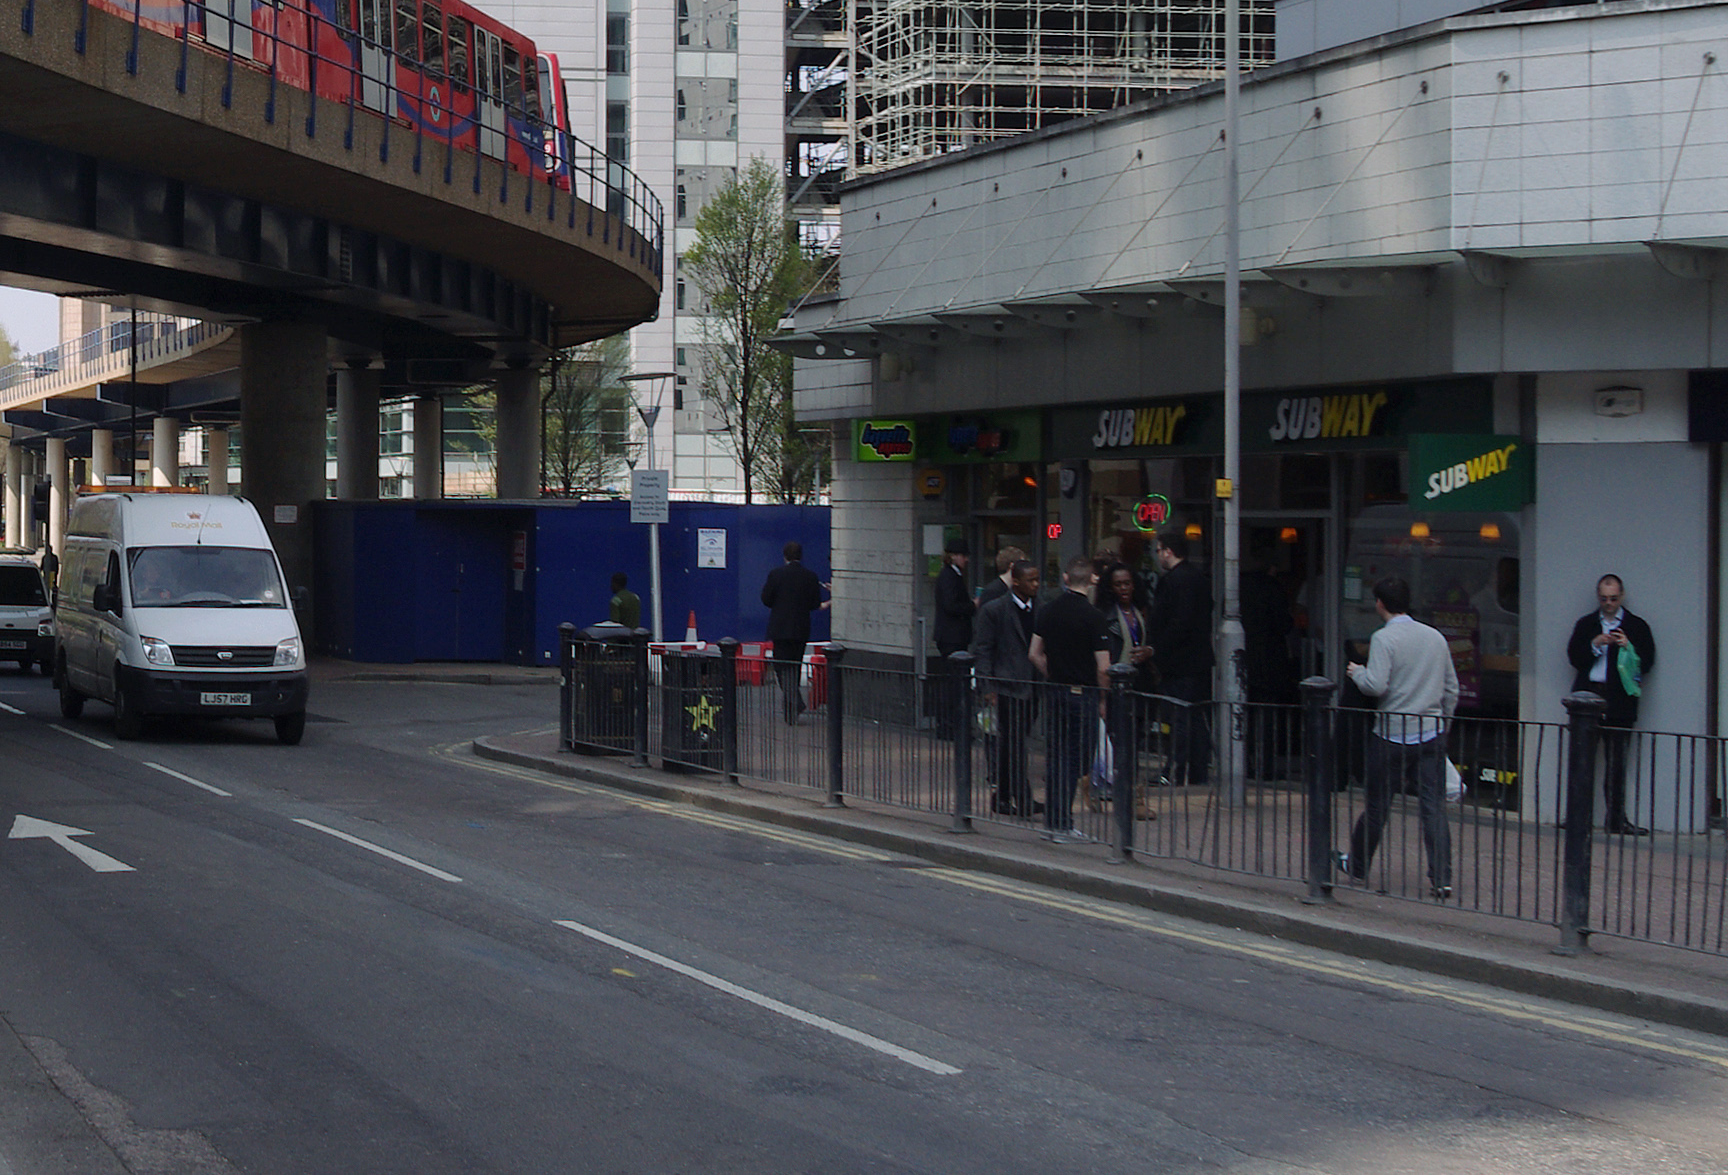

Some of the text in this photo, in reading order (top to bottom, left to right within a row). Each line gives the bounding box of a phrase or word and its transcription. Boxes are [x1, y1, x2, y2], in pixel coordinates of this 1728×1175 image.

[1092, 405, 1186, 448] SUBWAY
[1269, 391, 1388, 441] SUBWAY
[1424, 443, 1518, 500] SUBWAY
[1137, 503, 1166, 522] OPEN
